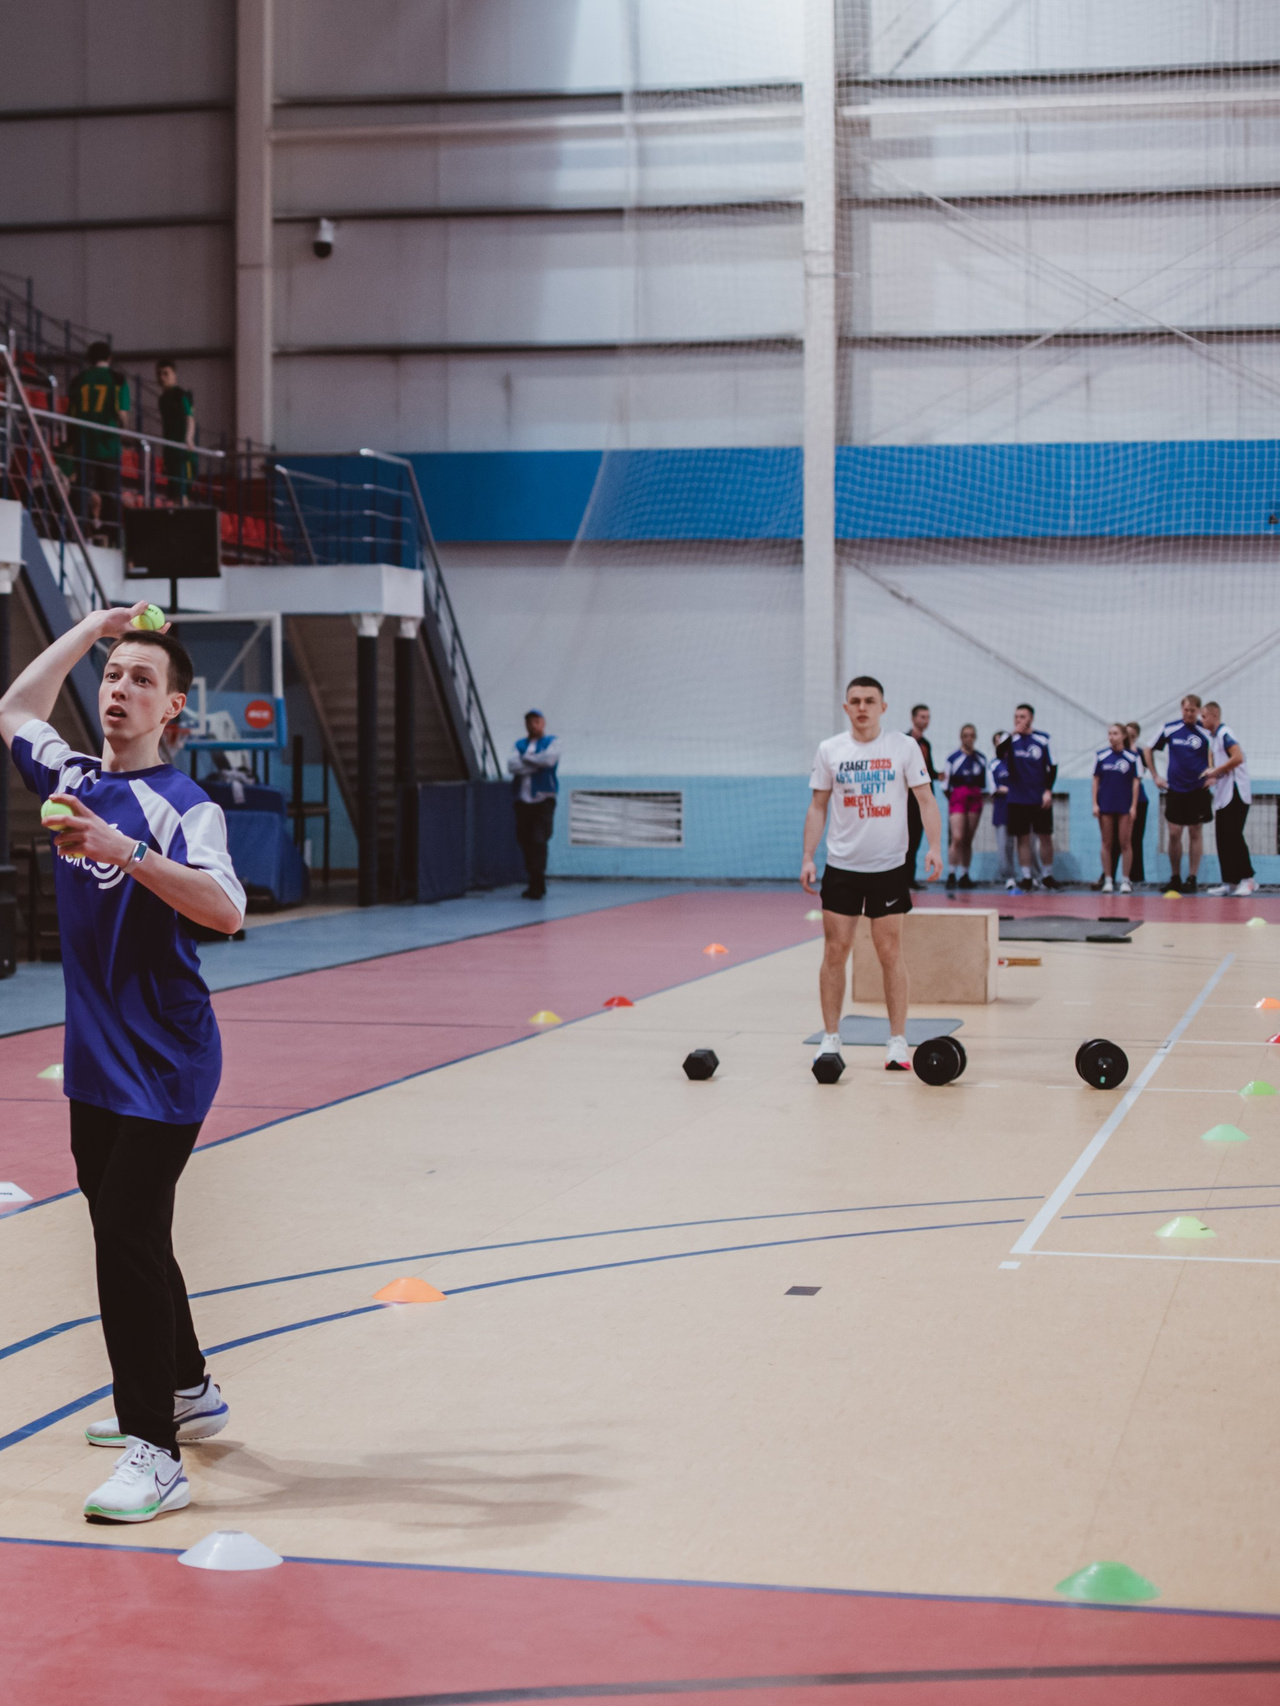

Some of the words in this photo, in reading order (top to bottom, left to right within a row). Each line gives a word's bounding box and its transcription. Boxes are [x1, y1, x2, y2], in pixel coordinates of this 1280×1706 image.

[81, 384, 107, 412] 17
[854, 770, 895, 783] ПЛАНЕТЫ
[861, 782, 886, 794] БЕГУТ
[843, 795, 873, 808] ВМЕСТЕ
[858, 807, 864, 818] С
